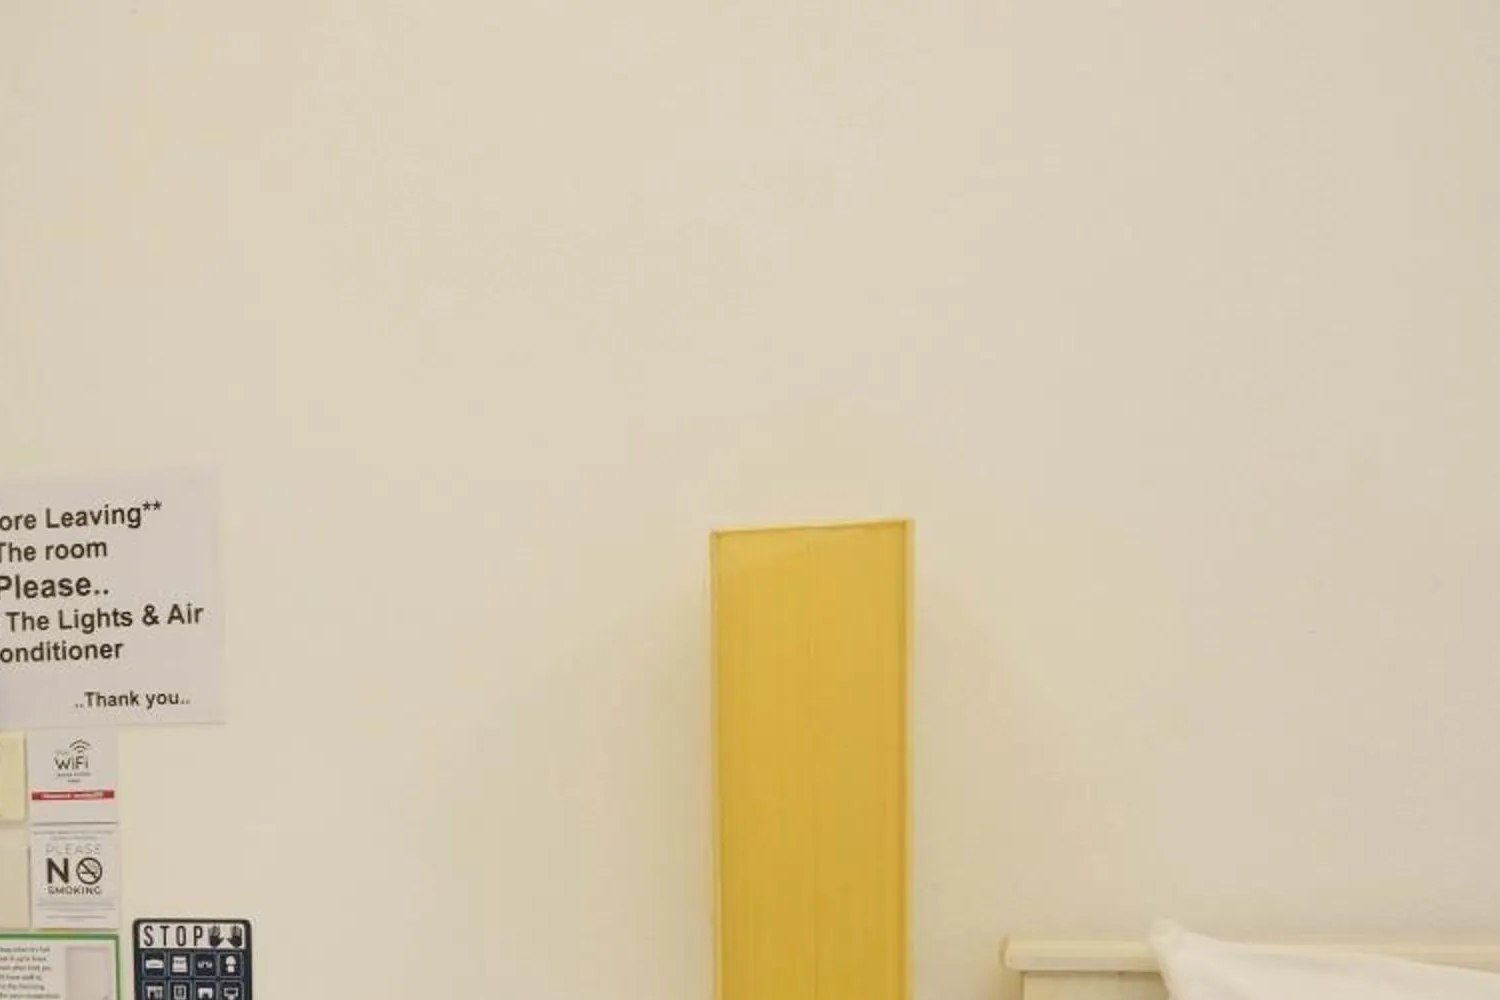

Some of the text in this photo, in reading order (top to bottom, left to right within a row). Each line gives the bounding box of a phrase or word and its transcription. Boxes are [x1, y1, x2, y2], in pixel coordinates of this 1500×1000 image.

[45, 541, 108, 560] room
[5, 611, 50, 632] The
[58, 608, 133, 635] Lights
[142, 604, 160, 627] &
[167, 602, 204, 624] Air
[45, 842, 102, 855] PLEASE
[47, 885, 102, 895] SMOKING
[143, 924, 204, 947] STOP
